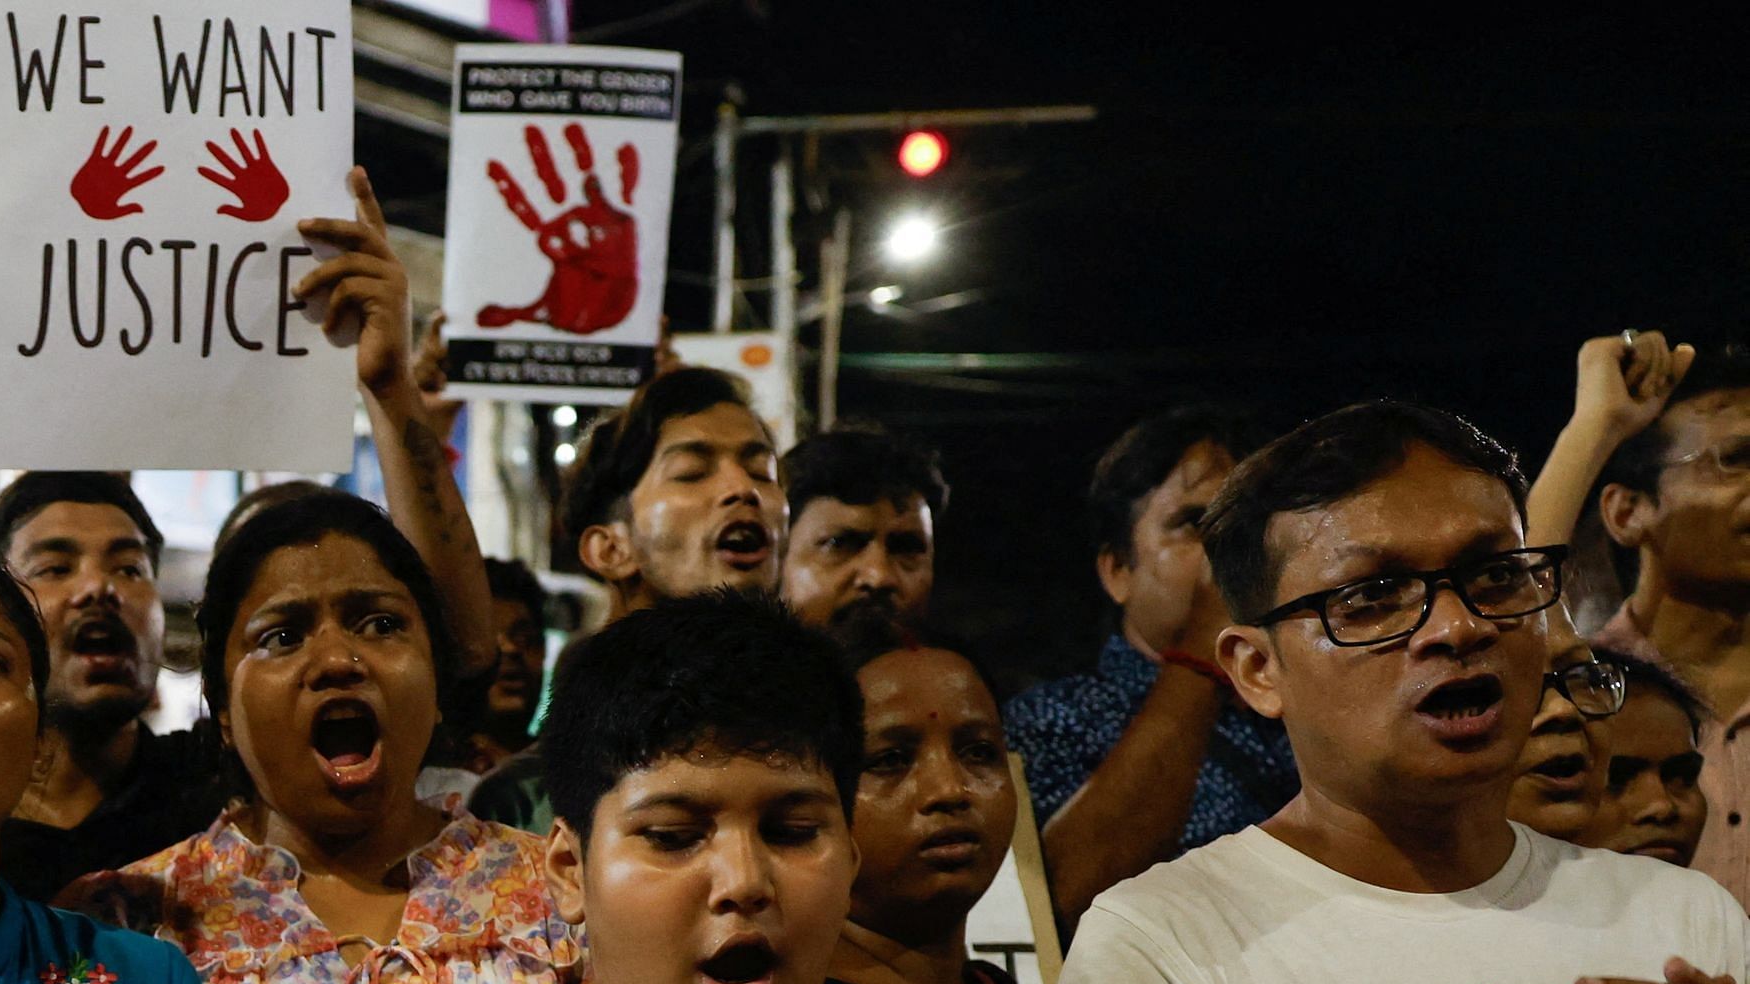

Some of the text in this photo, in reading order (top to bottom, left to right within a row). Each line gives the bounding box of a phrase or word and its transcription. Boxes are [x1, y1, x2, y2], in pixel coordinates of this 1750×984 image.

[7, 12, 336, 118] WE WANT
[467, 67, 673, 93] PROTECT THE GENDER
[466, 90, 672, 115] WHO GAVE YOU BIRTH
[18, 237, 312, 357] JUSTICE
